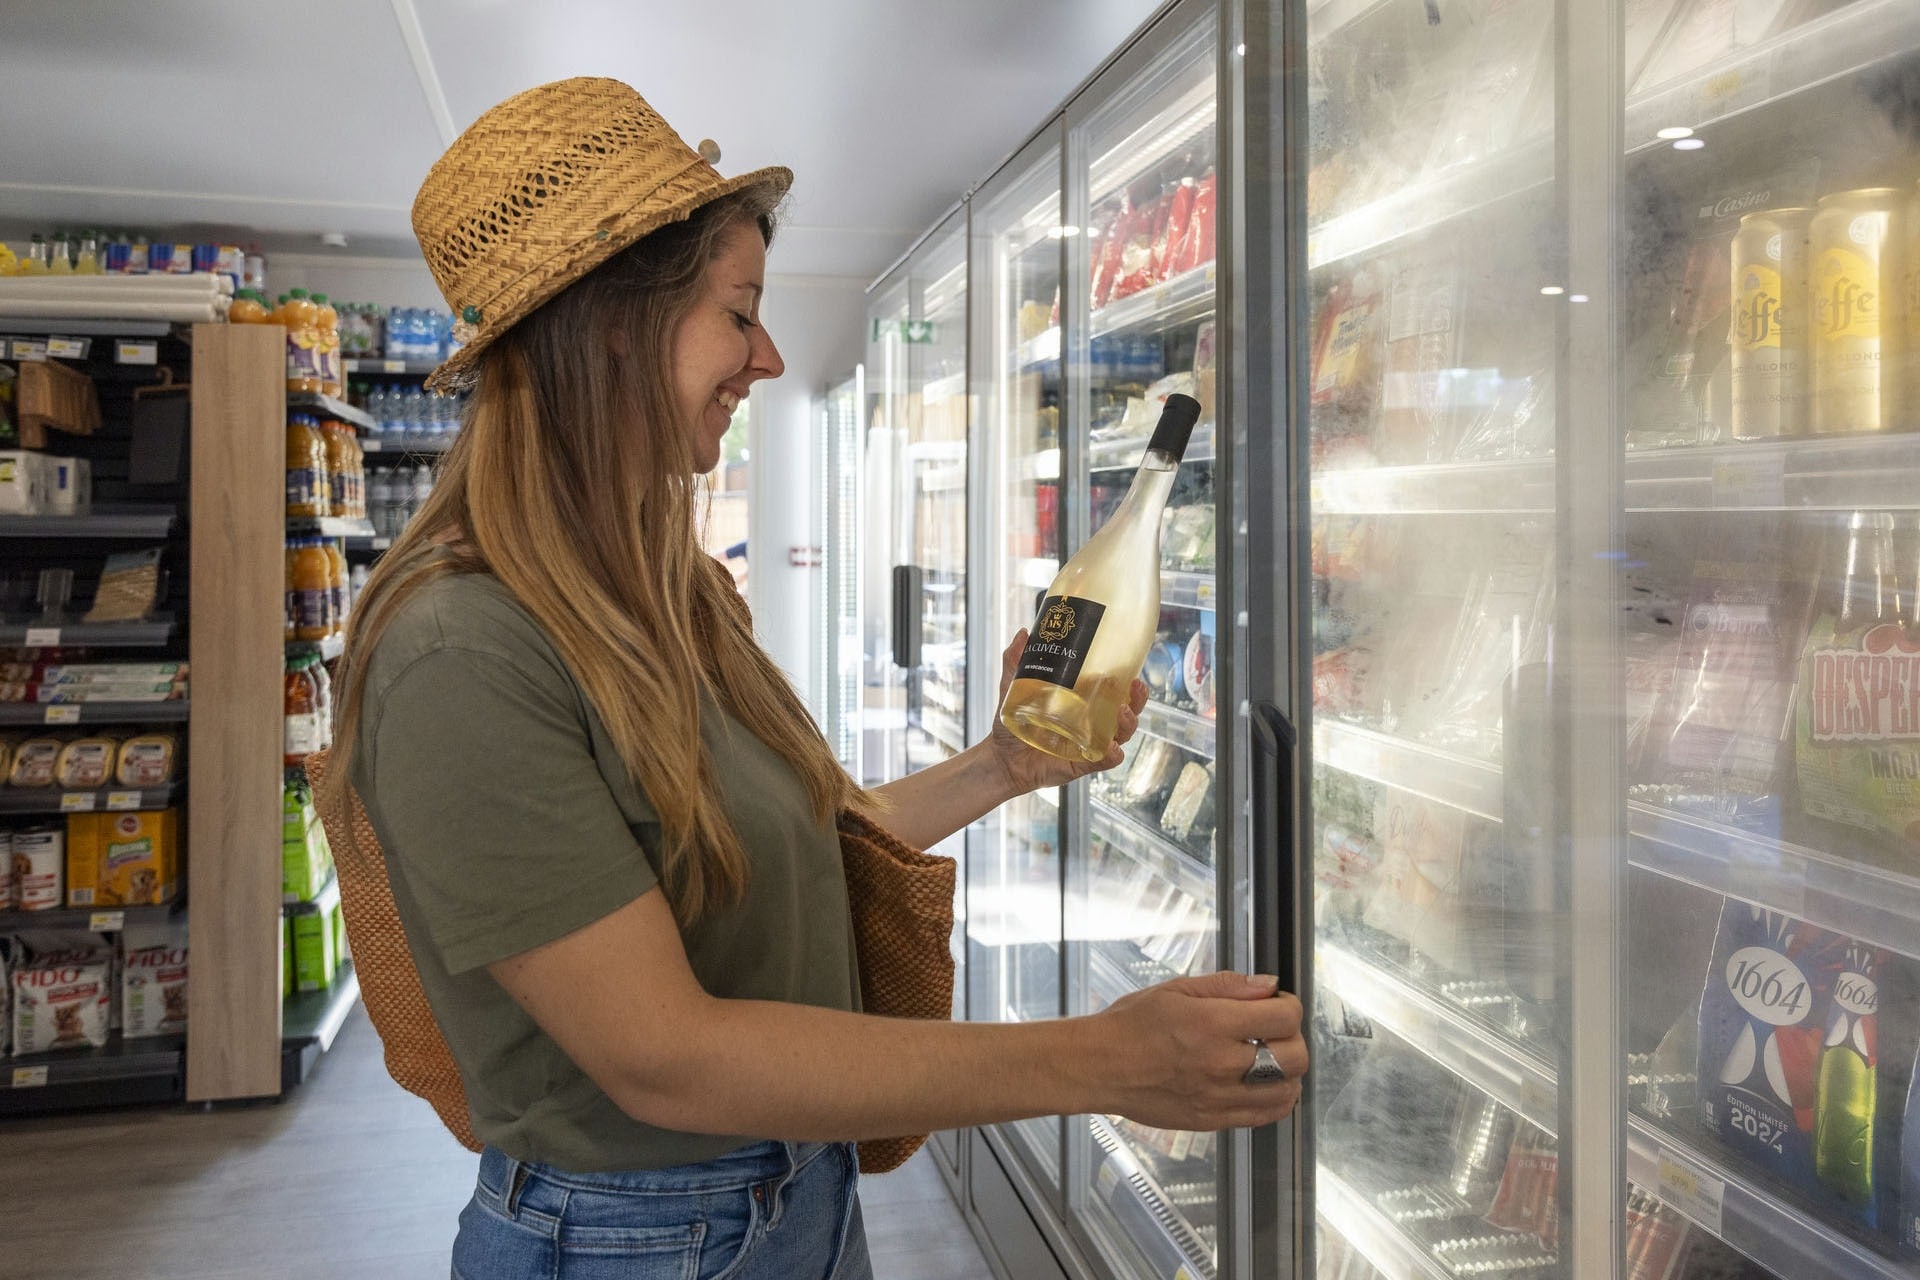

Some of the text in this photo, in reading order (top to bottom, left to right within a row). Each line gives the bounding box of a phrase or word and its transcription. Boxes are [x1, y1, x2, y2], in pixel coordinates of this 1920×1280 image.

[1713, 191, 1771, 217] Casino
[1032, 642, 1061, 655] CUVÉE
[1061, 647, 1078, 659] MS
[16, 967, 81, 987] FIDO
[1731, 960, 1806, 1016] 1664
[1835, 979, 1879, 1010] 1664
[1727, 1092, 1790, 1133] ÉDITION LIMITÉE
[1730, 1107, 1784, 1155] 2024
